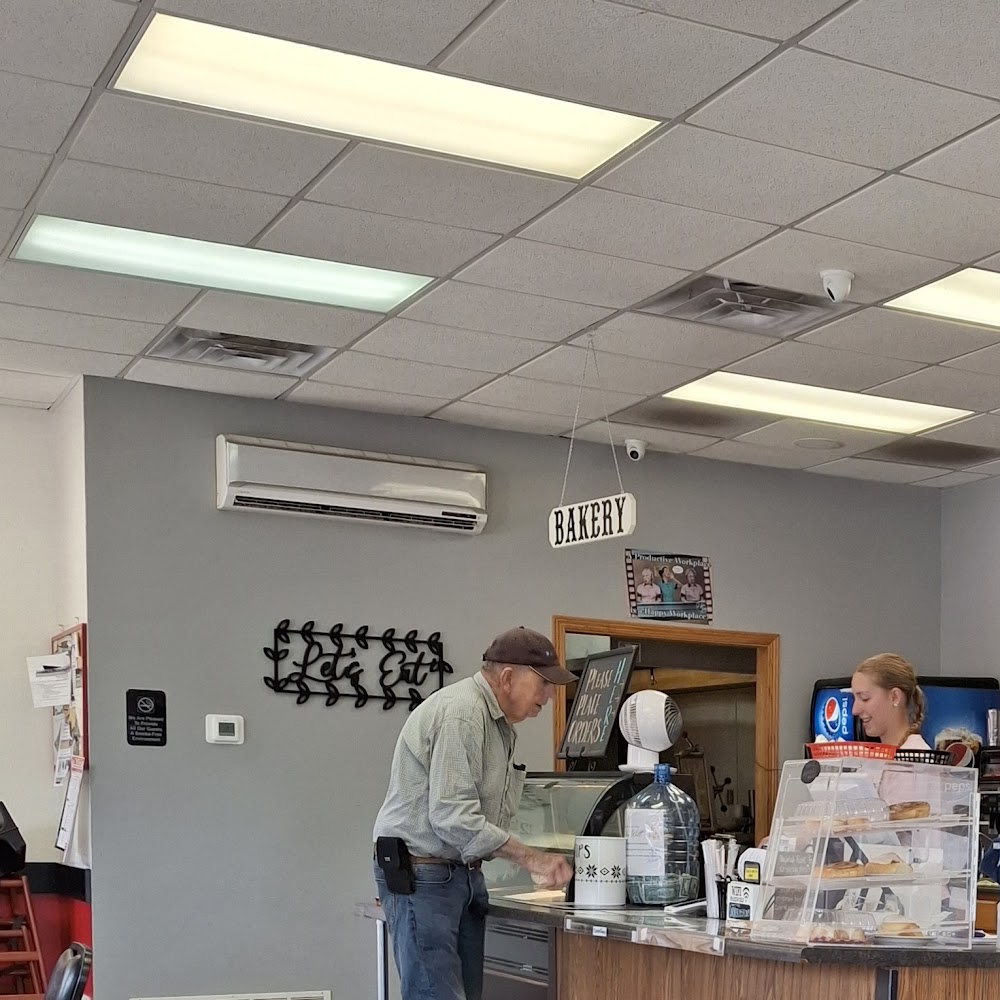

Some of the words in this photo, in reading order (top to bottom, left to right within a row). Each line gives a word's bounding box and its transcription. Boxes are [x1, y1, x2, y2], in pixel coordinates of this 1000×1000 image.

[554, 496, 626, 545] BAKERY
[635, 552, 675, 563] Productive
[675, 557, 711, 567] Workplace
[645, 608, 667, 617] Happy
[668, 609, 707, 619] Workplace
[293, 641, 364, 687] Let's
[379, 650, 434, 688] Eat
[585, 668, 614, 692] PLEASE
[567, 717, 602, 744] ORDERS
[945, 782, 971, 793] peps
